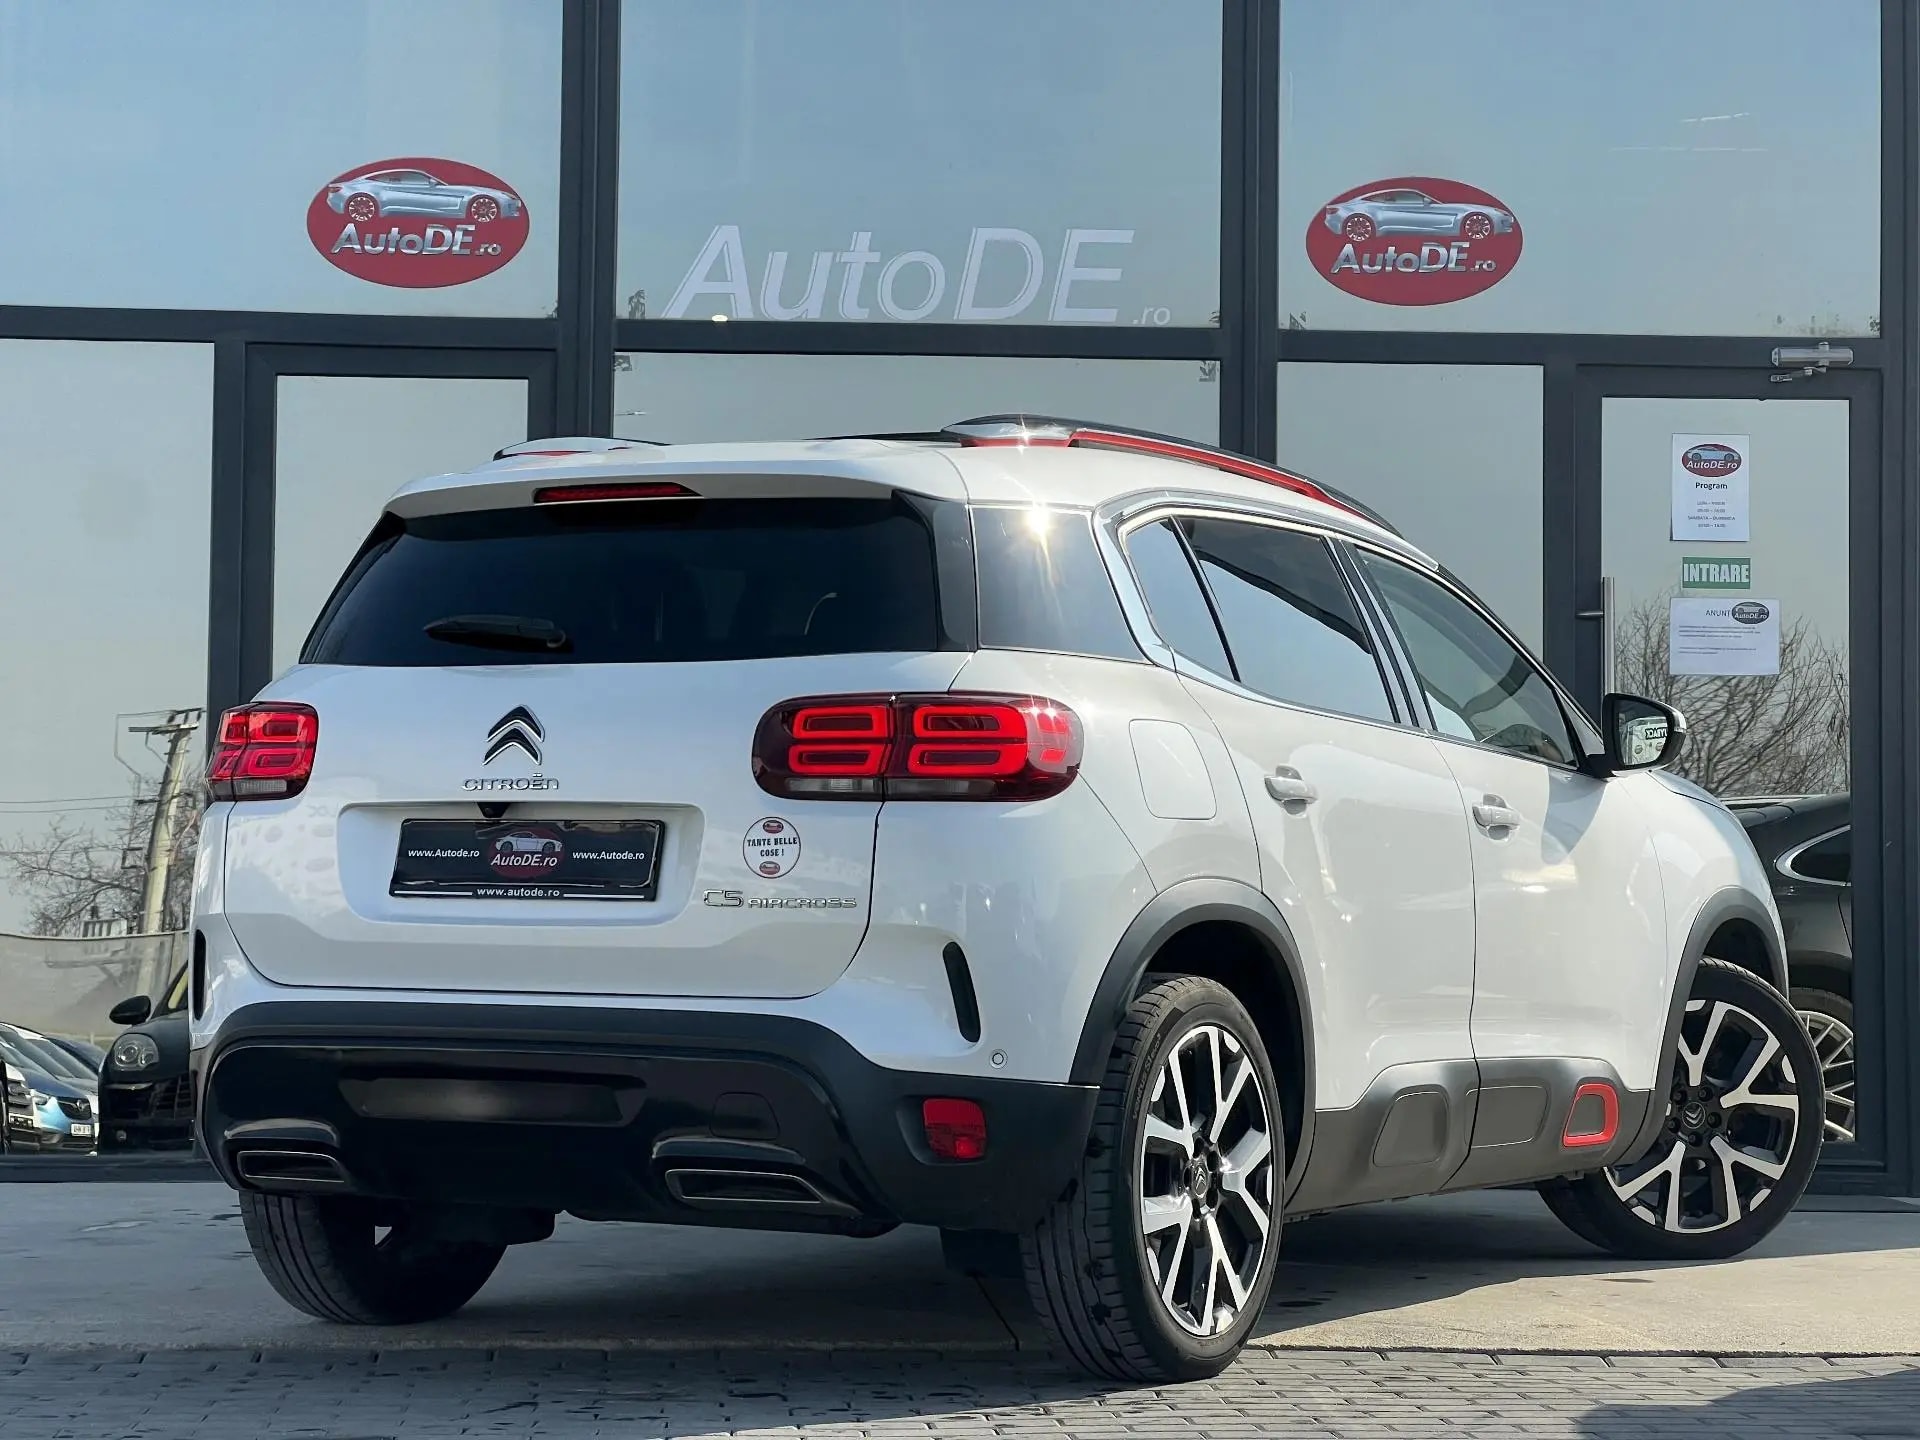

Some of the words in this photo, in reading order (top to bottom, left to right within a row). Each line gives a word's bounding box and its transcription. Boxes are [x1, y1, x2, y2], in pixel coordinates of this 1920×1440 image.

[1686, 461, 1738, 469] AutoDE.ro
[1695, 482, 1728, 490] Program
[1683, 563, 1749, 582] INTRARE
[747, 838, 771, 847] TANTE
[774, 837, 798, 845] BELLE
[408, 849, 480, 858] www.Autode.ro
[572, 851, 645, 860] www.Autode.ro
[760, 848, 779, 857] COSE
[491, 854, 558, 867] AutoDE.ro
[477, 887, 560, 897] www.autode.ro
[704, 889, 744, 907] C5
[748, 898, 857, 908] AIRCROSS
